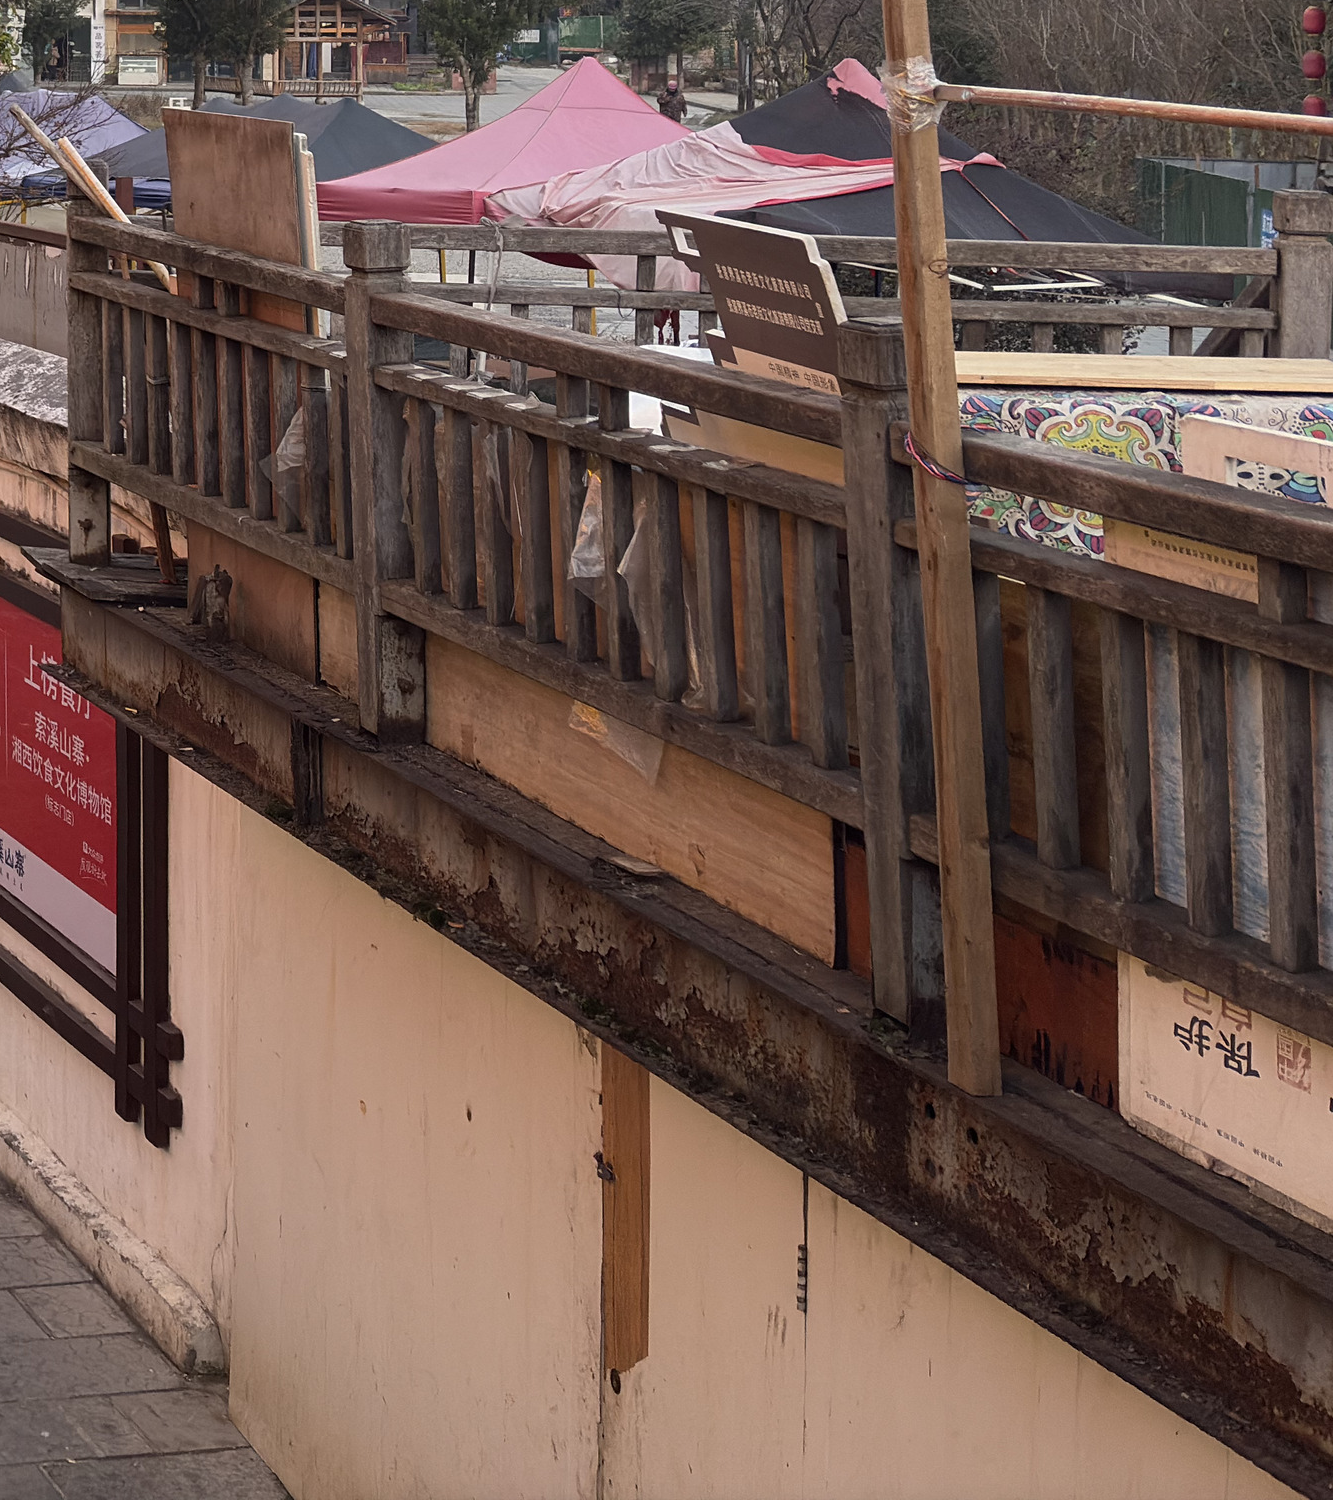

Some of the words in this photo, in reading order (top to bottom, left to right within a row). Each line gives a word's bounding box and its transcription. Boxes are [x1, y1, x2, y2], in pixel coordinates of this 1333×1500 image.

[11, 735, 113, 827] 湘西饮食文化博物馆
[1173, 1015, 1261, 1079] 保护
